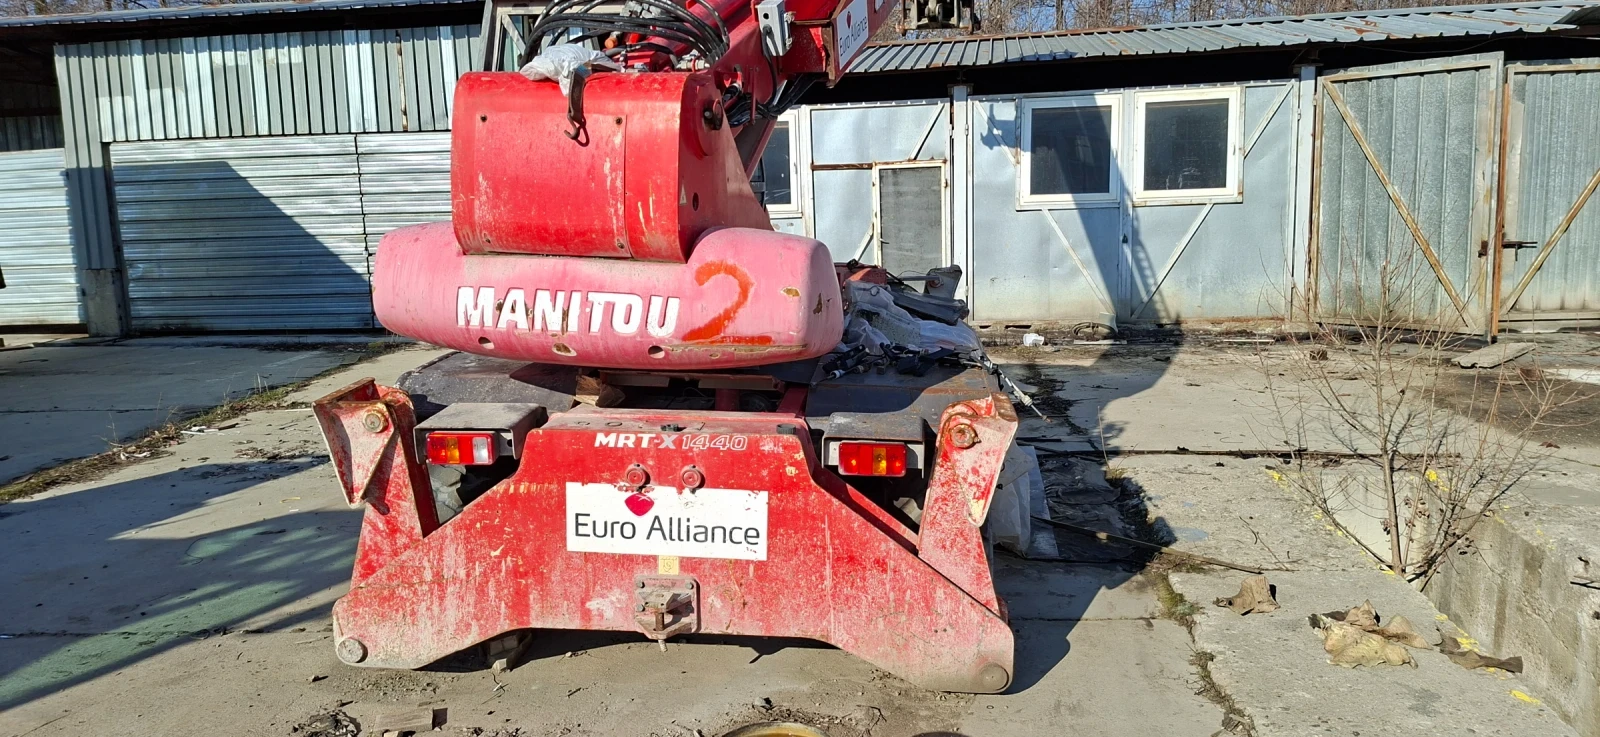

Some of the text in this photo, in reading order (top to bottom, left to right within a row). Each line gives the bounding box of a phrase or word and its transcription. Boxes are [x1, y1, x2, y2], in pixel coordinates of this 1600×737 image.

[840, 35, 850, 57] Euro
[456, 286, 681, 337] MANITOU
[682, 262, 773, 345] 2
[594, 432, 748, 451] MRT-X 1440
[574, 513, 760, 546] Euro Alliance
